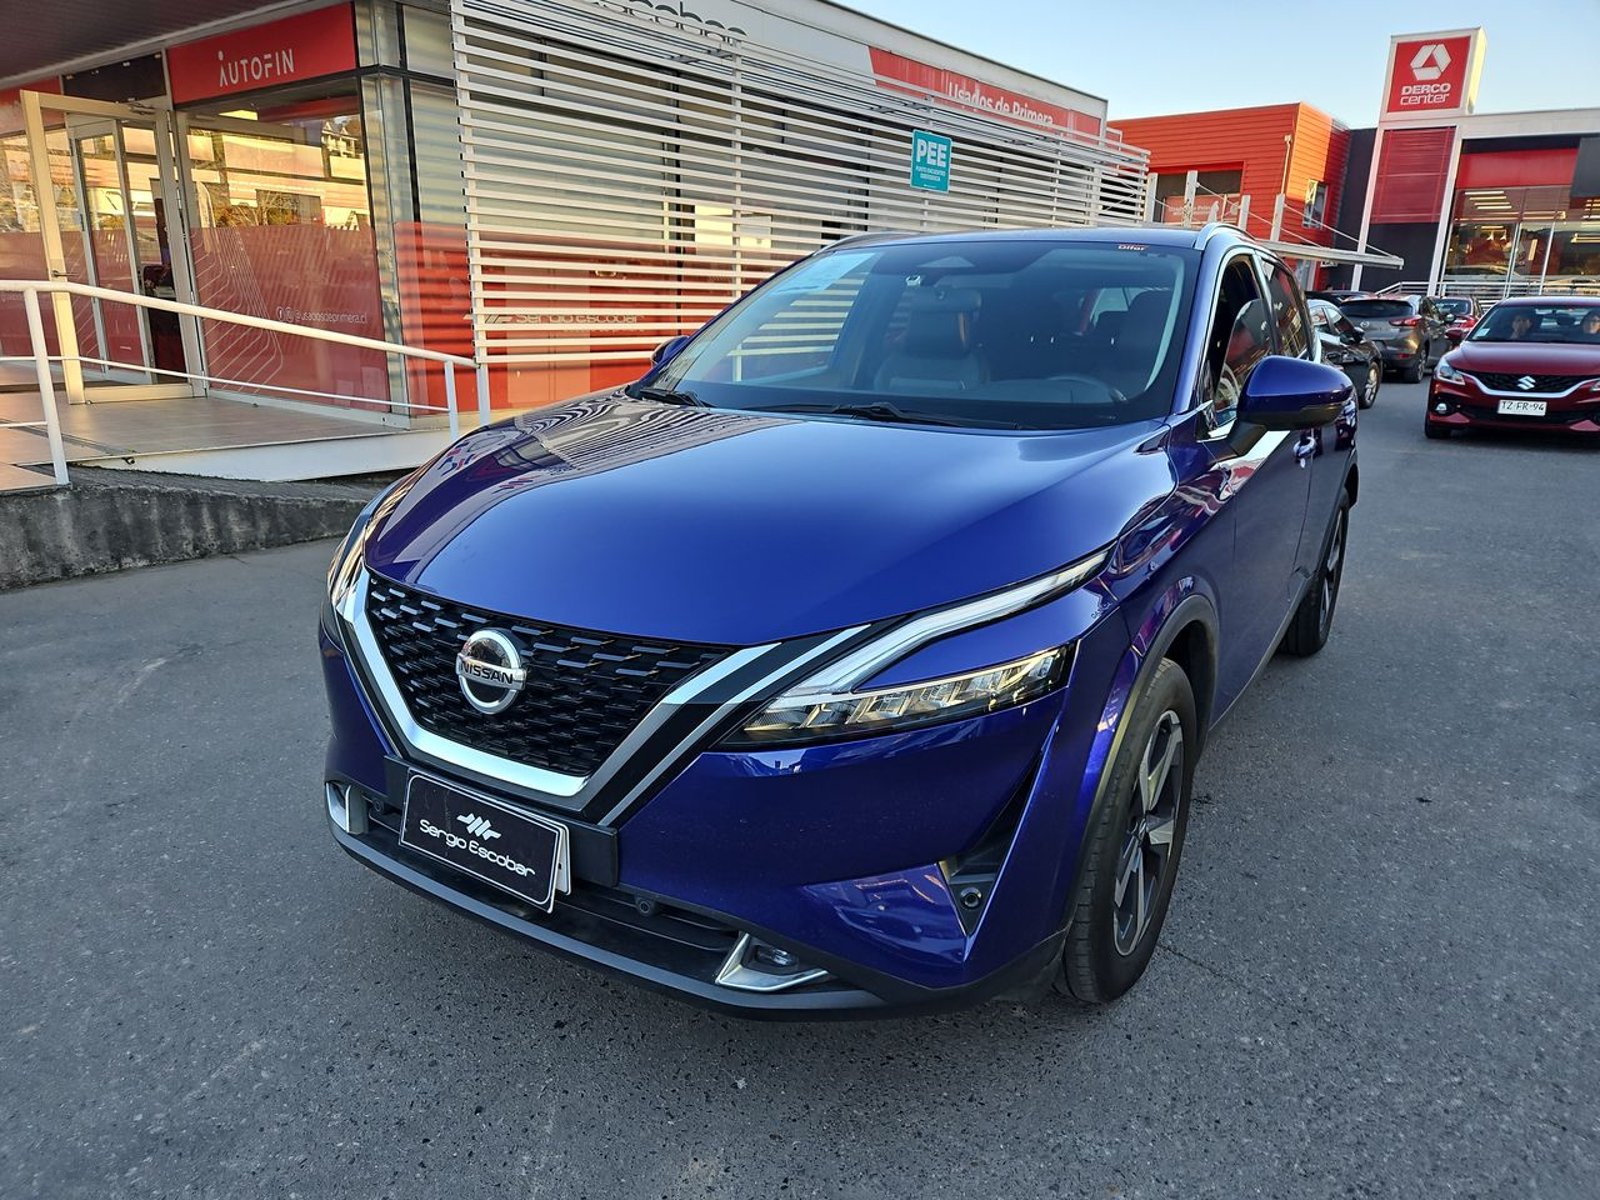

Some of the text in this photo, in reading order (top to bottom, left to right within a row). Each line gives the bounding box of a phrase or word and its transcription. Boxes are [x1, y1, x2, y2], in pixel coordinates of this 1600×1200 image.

[217, 48, 295, 88] AUTOFIN
[1400, 93, 1450, 106] center
[1401, 83, 1451, 96] DERCO
[915, 138, 947, 168] PEE
[462, 660, 514, 684] NISSAN
[419, 819, 536, 877] Sergio Escobar
